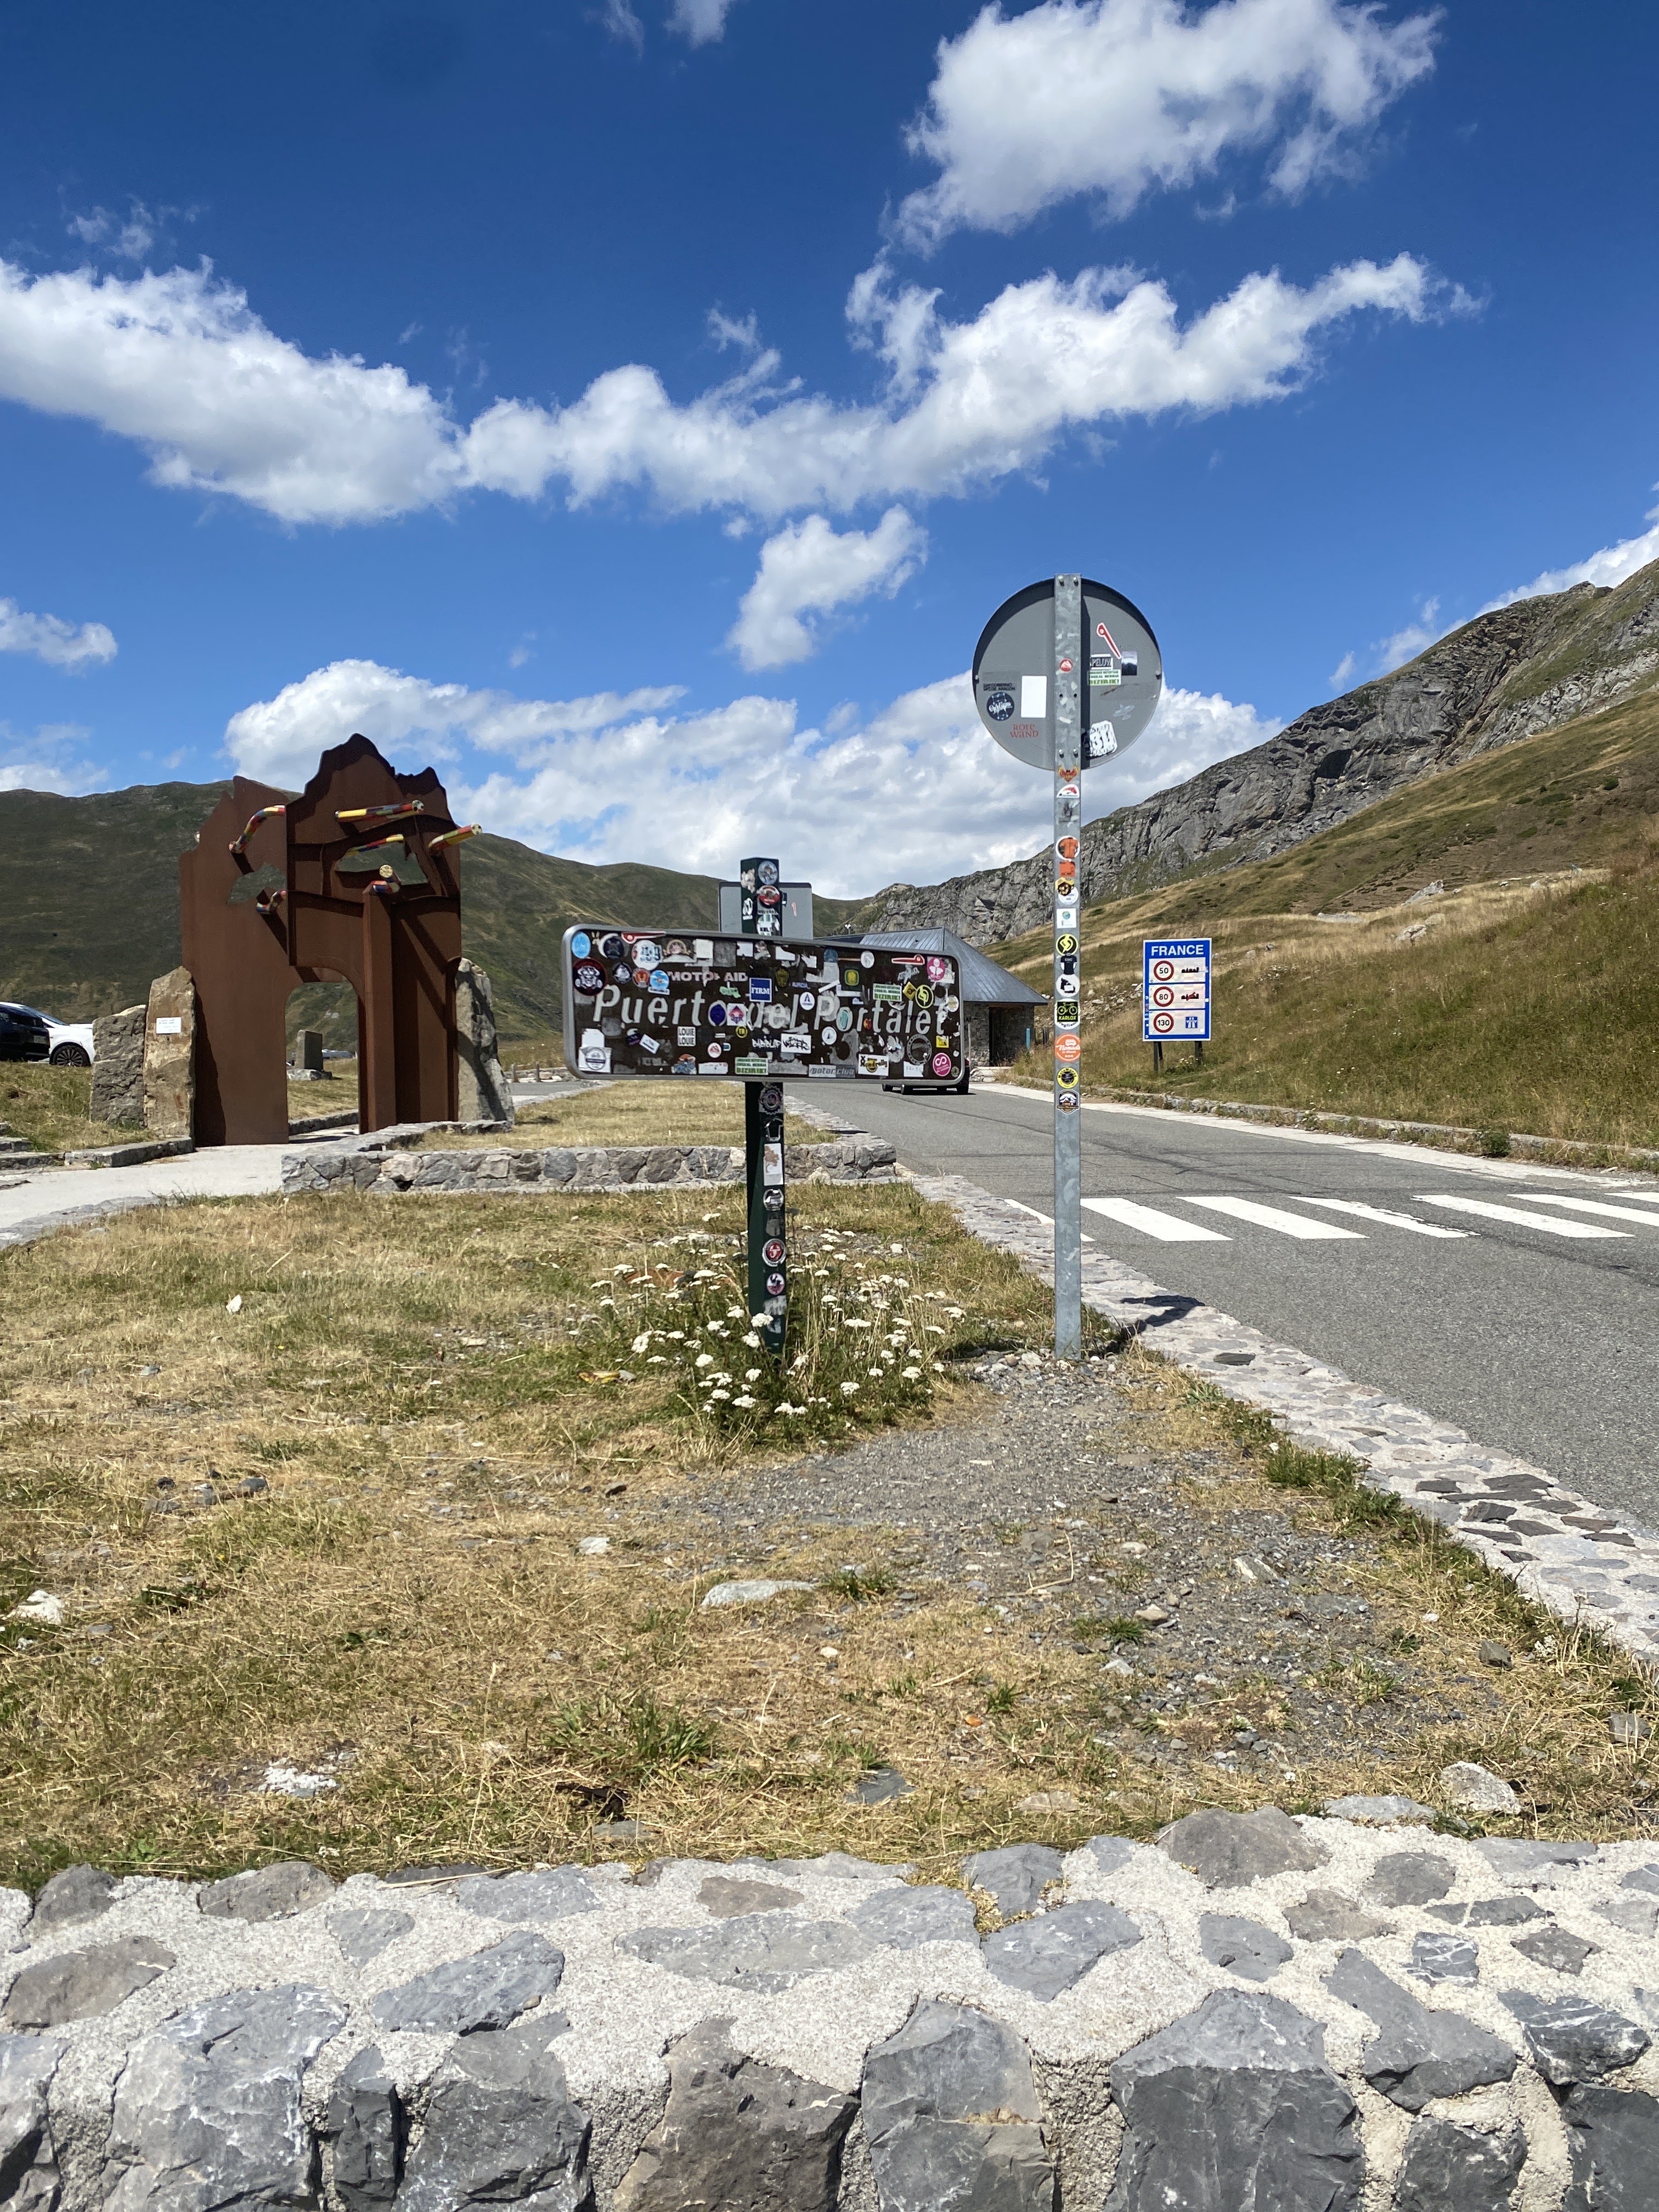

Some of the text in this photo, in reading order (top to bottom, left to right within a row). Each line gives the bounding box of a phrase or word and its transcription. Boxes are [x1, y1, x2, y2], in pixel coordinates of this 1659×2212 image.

[1151, 945, 1204, 956] FRANCE
[592, 984, 728, 1027] Puerto
[814, 994, 945, 1036] Portalet
